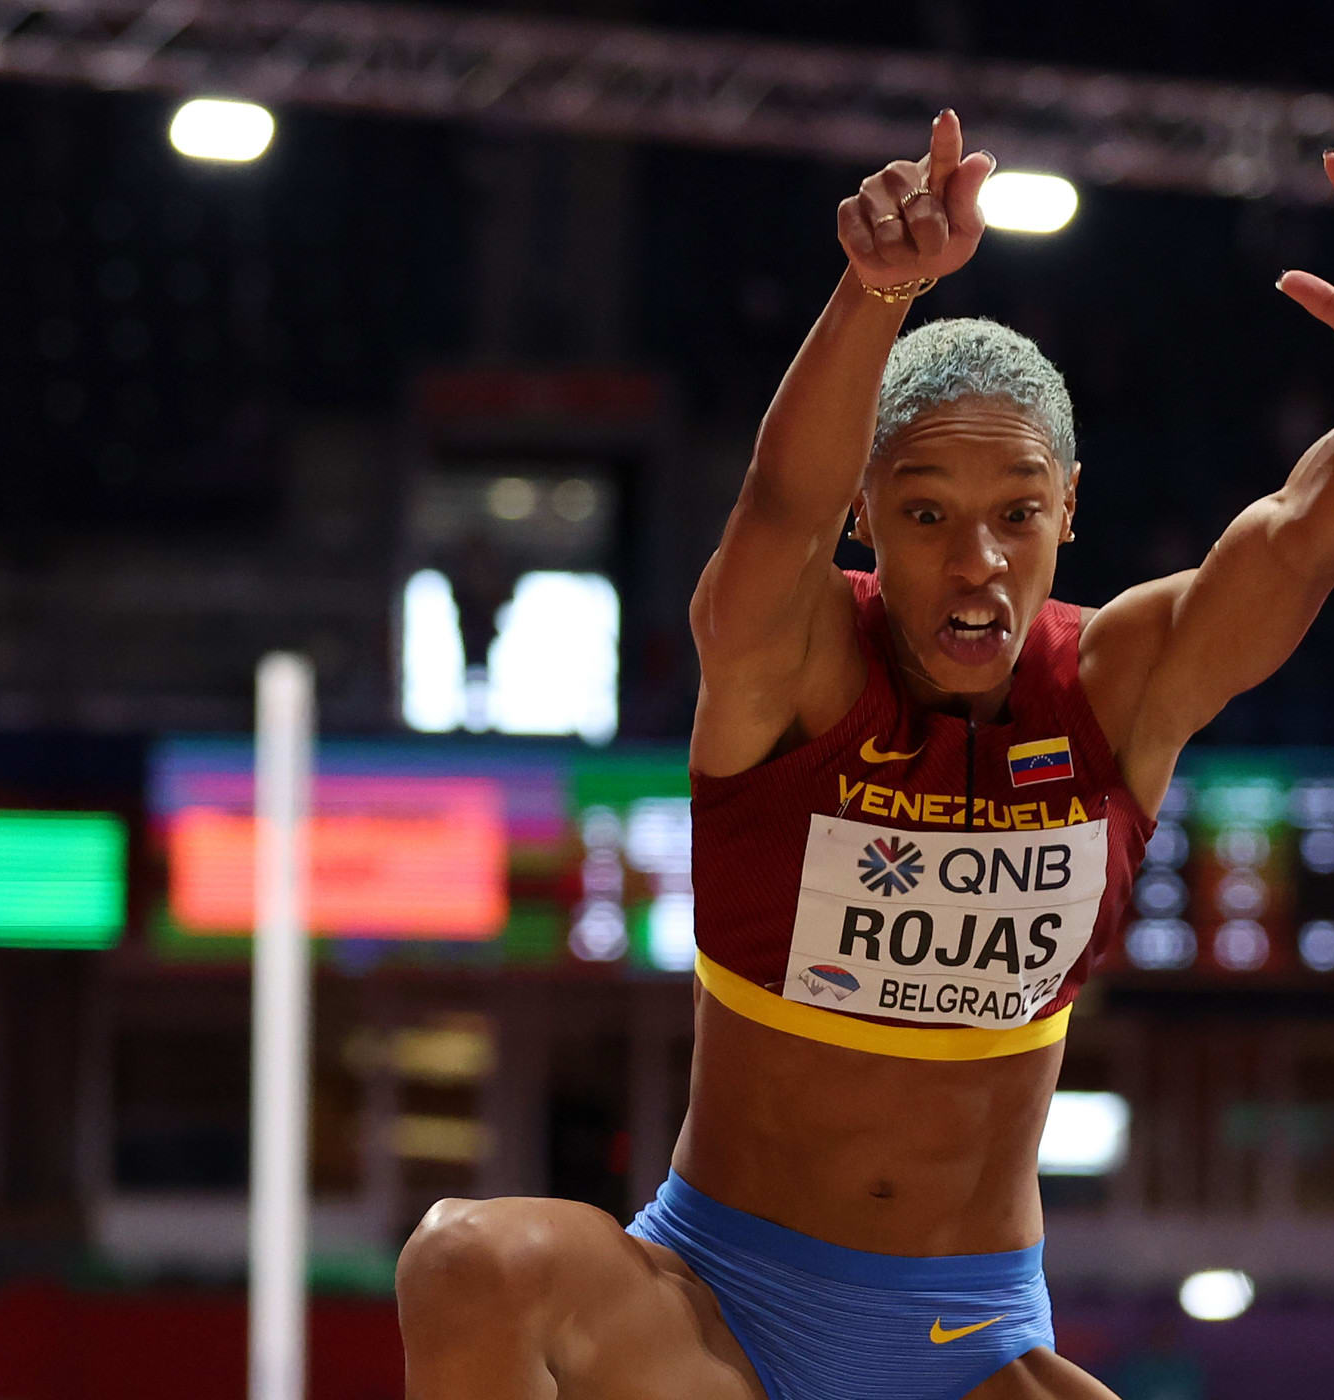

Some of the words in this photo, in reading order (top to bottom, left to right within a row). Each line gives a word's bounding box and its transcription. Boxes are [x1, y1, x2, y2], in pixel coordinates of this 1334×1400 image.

[838, 773, 1089, 830] VENEZUELA
[938, 844, 1072, 895] QNB
[838, 906, 1063, 974] ROJAS
[1031, 972, 1062, 1005] 22
